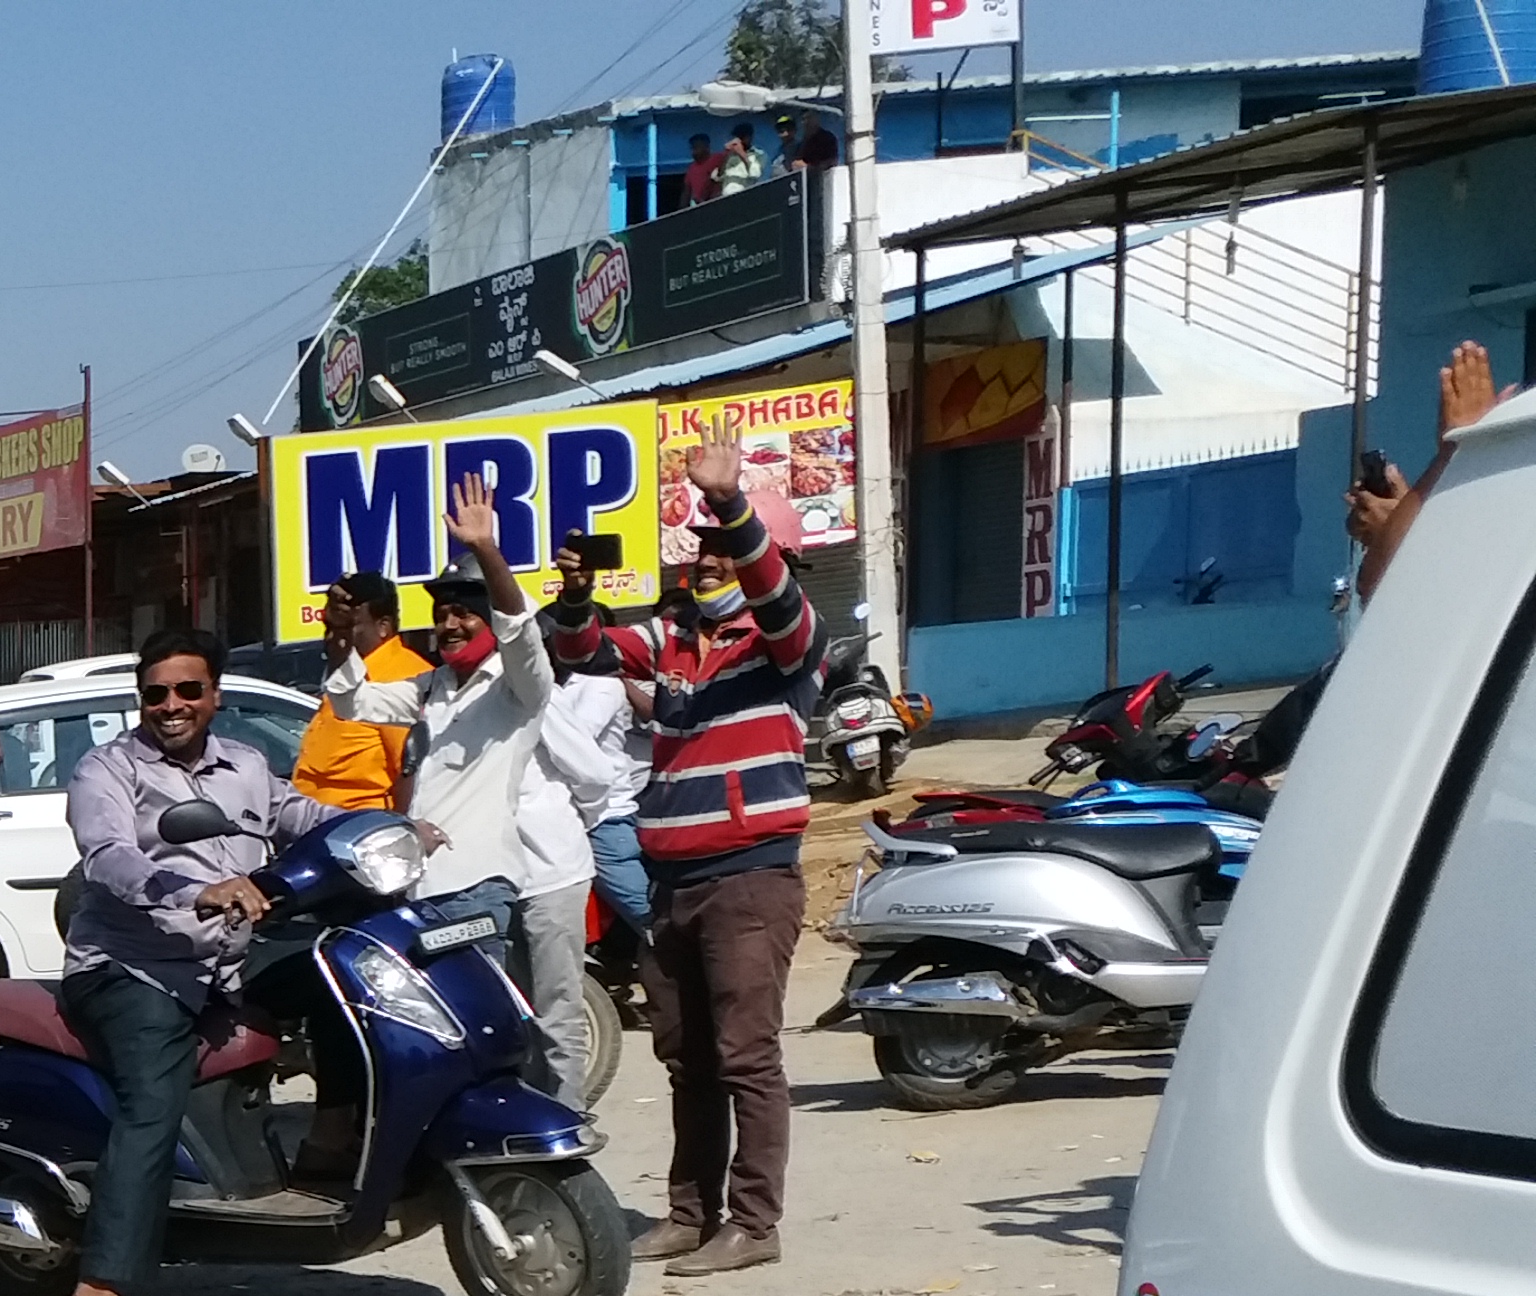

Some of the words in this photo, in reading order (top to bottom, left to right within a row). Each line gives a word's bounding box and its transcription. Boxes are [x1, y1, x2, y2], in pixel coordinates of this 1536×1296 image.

[577, 254, 627, 321] HUNTER
[669, 277, 688, 291] BUT
[692, 264, 728, 284] REALLY
[733, 249, 777, 273] SMOOTH
[724, 389, 839, 429] DHABA
[41, 415, 84, 470] SHOP
[304, 427, 637, 589] MRP
